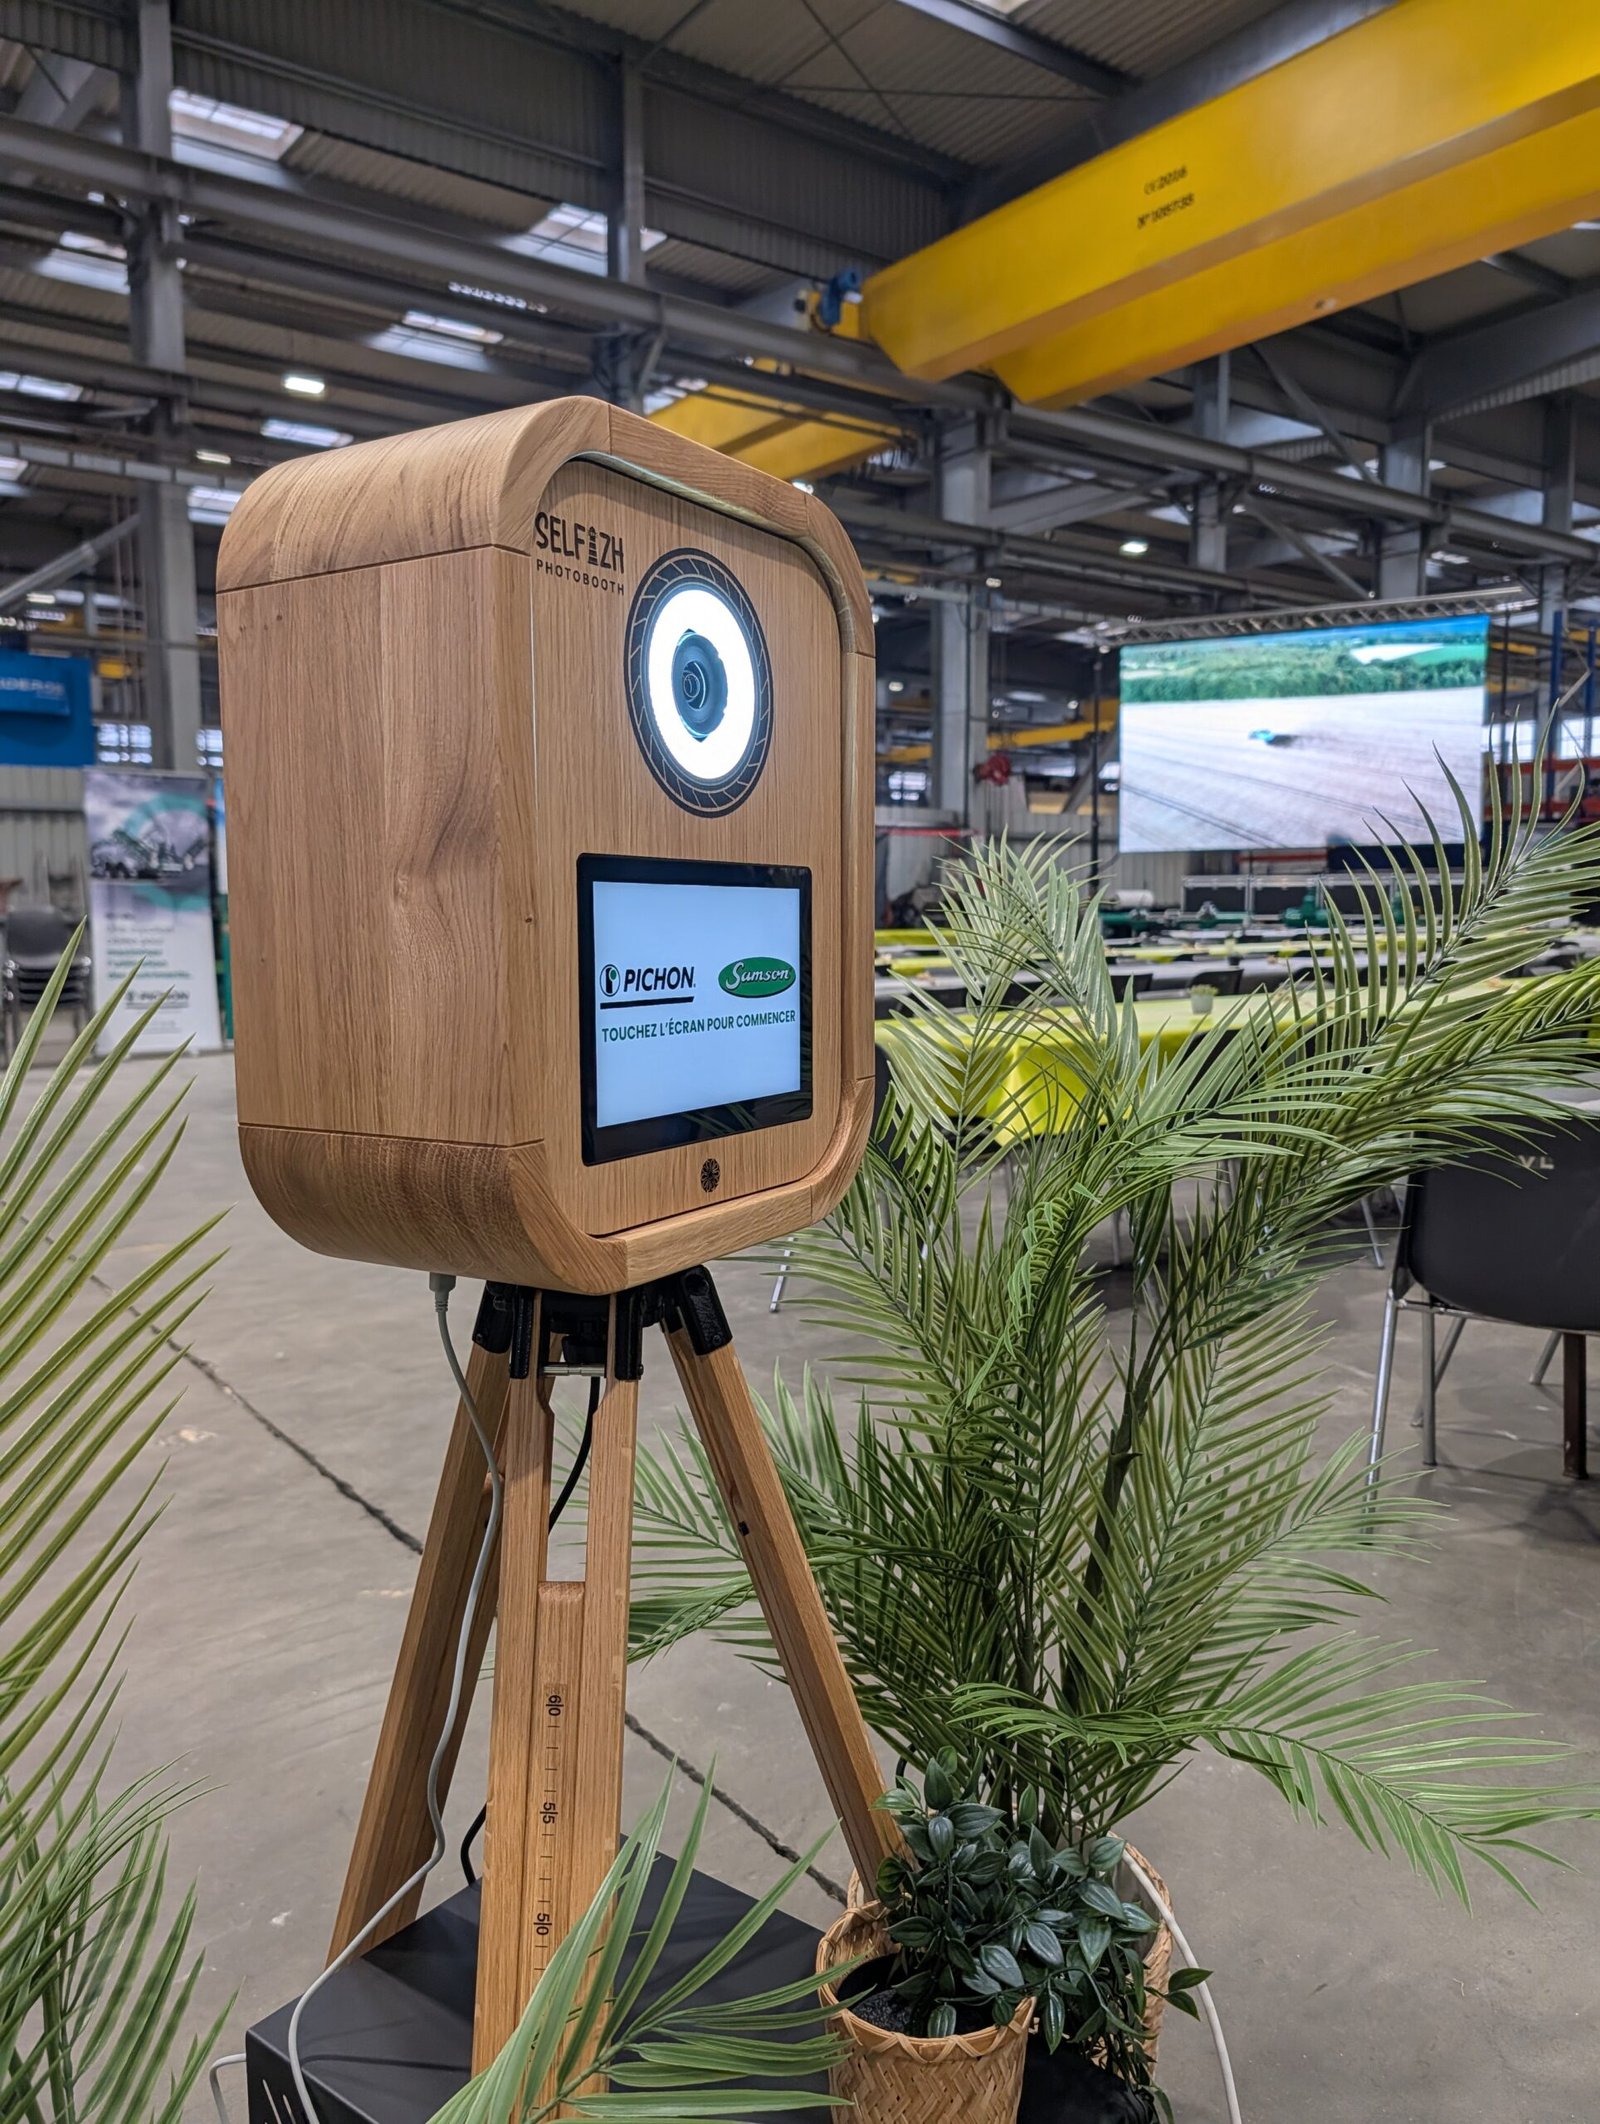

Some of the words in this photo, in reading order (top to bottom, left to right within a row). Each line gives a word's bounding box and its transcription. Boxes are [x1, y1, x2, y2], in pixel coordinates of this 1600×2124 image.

[536, 558, 624, 596] PHOTOBOOTH
[623, 966, 695, 992] PICHON
[726, 961, 789, 990] Samson
[602, 1023, 657, 1043] TOUCHEZ
[660, 1017, 705, 1036] L'ÉCRAN
[707, 1016, 734, 1032] POUR
[736, 1009, 796, 1028] COMMENCER
